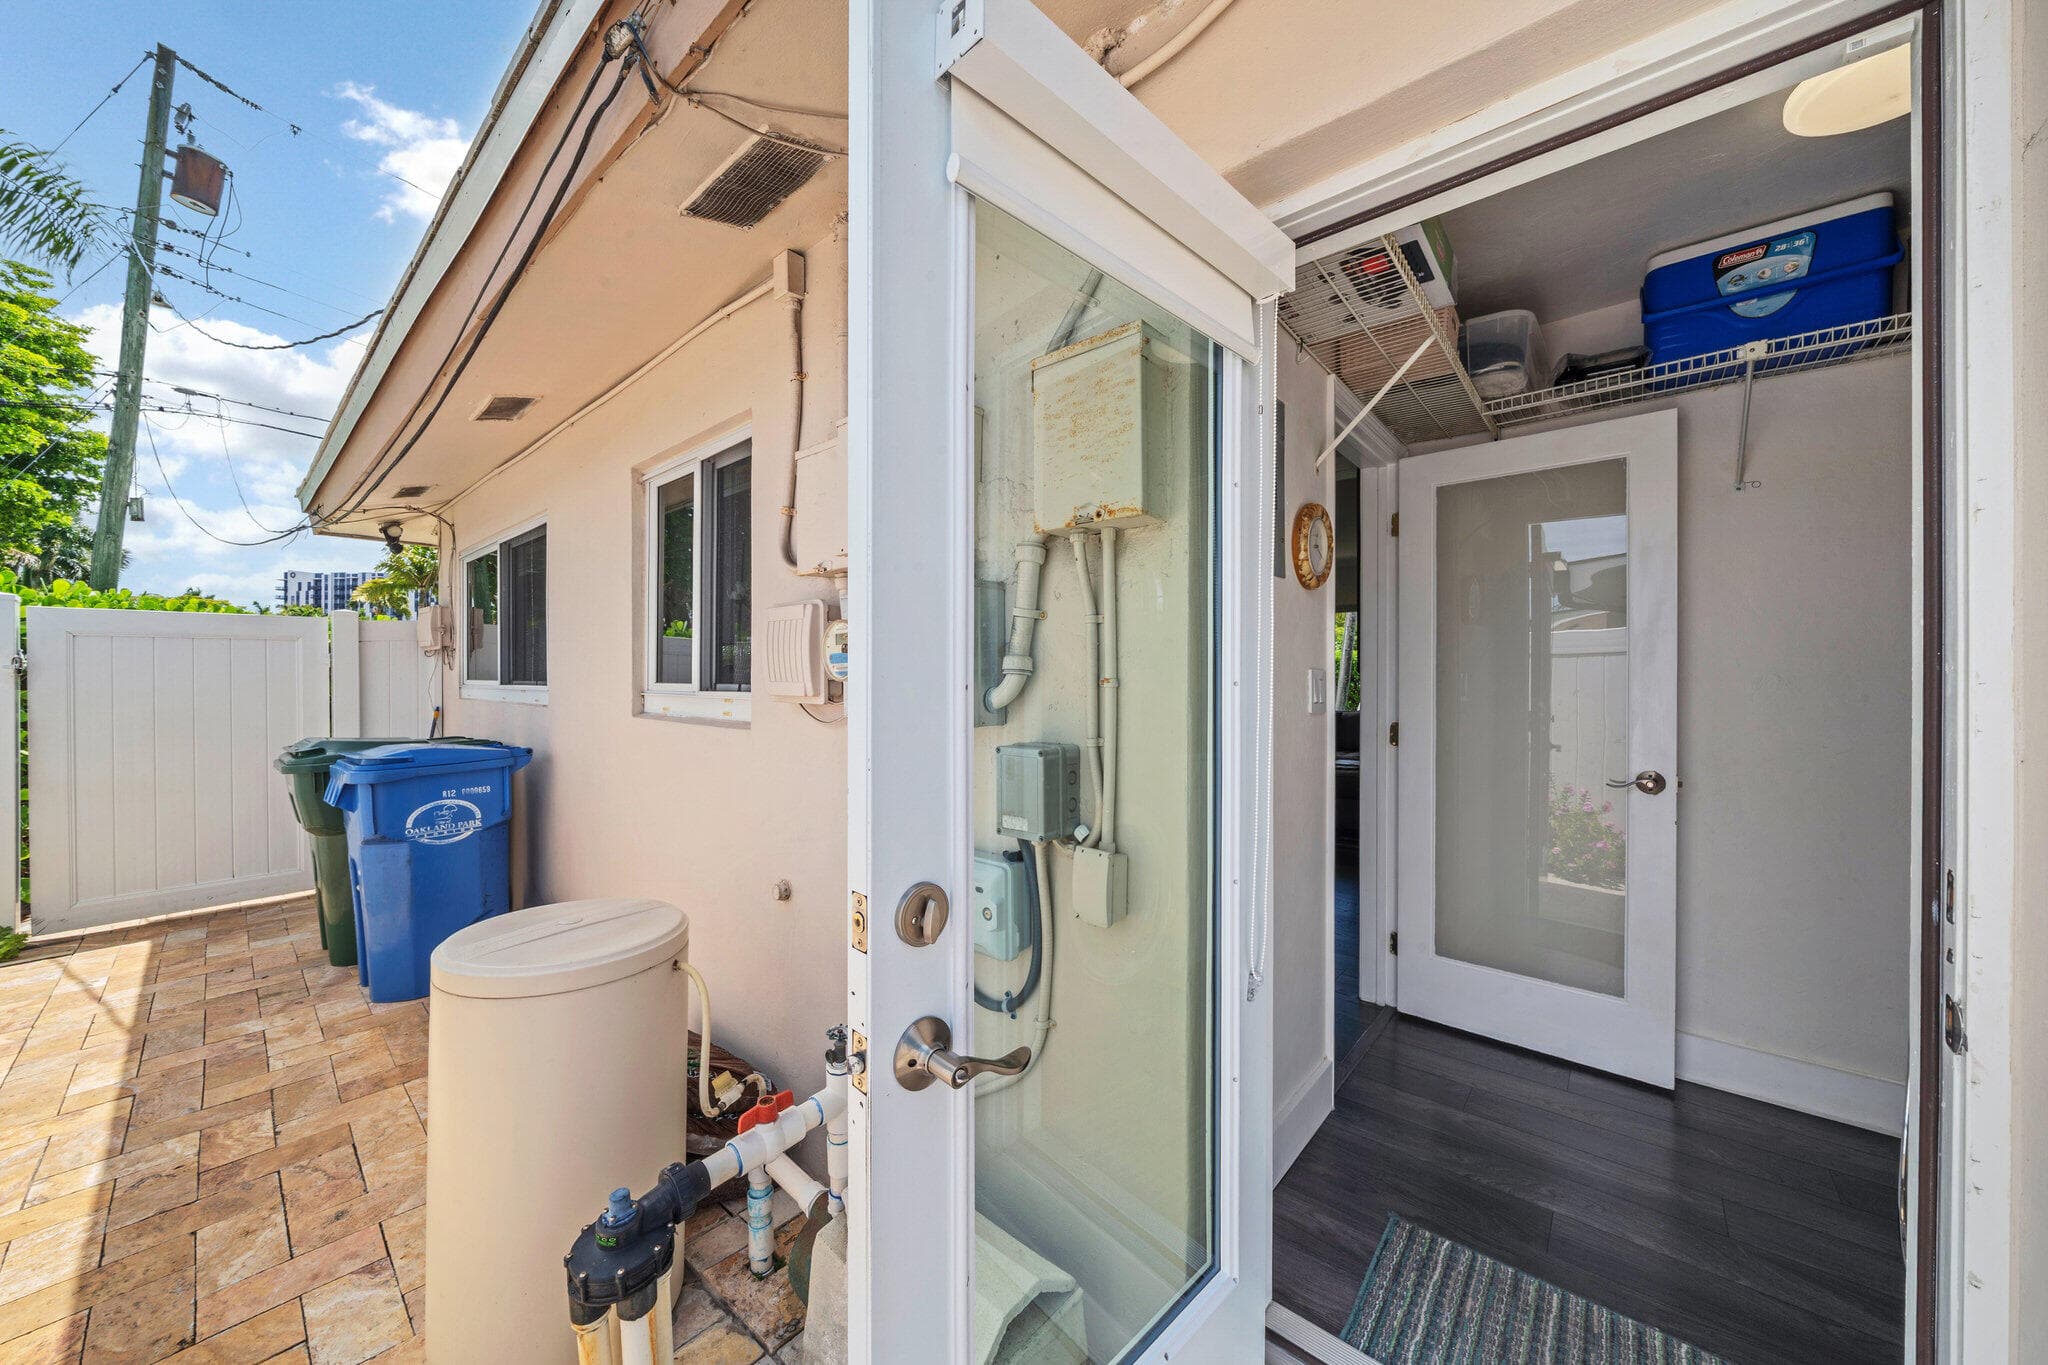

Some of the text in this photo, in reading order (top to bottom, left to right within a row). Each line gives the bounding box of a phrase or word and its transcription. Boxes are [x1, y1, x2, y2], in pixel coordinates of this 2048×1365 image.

[1722, 251, 1755, 263] Coleman
[405, 823, 455, 835] OAKLAND
[457, 818, 482, 828] PARK
